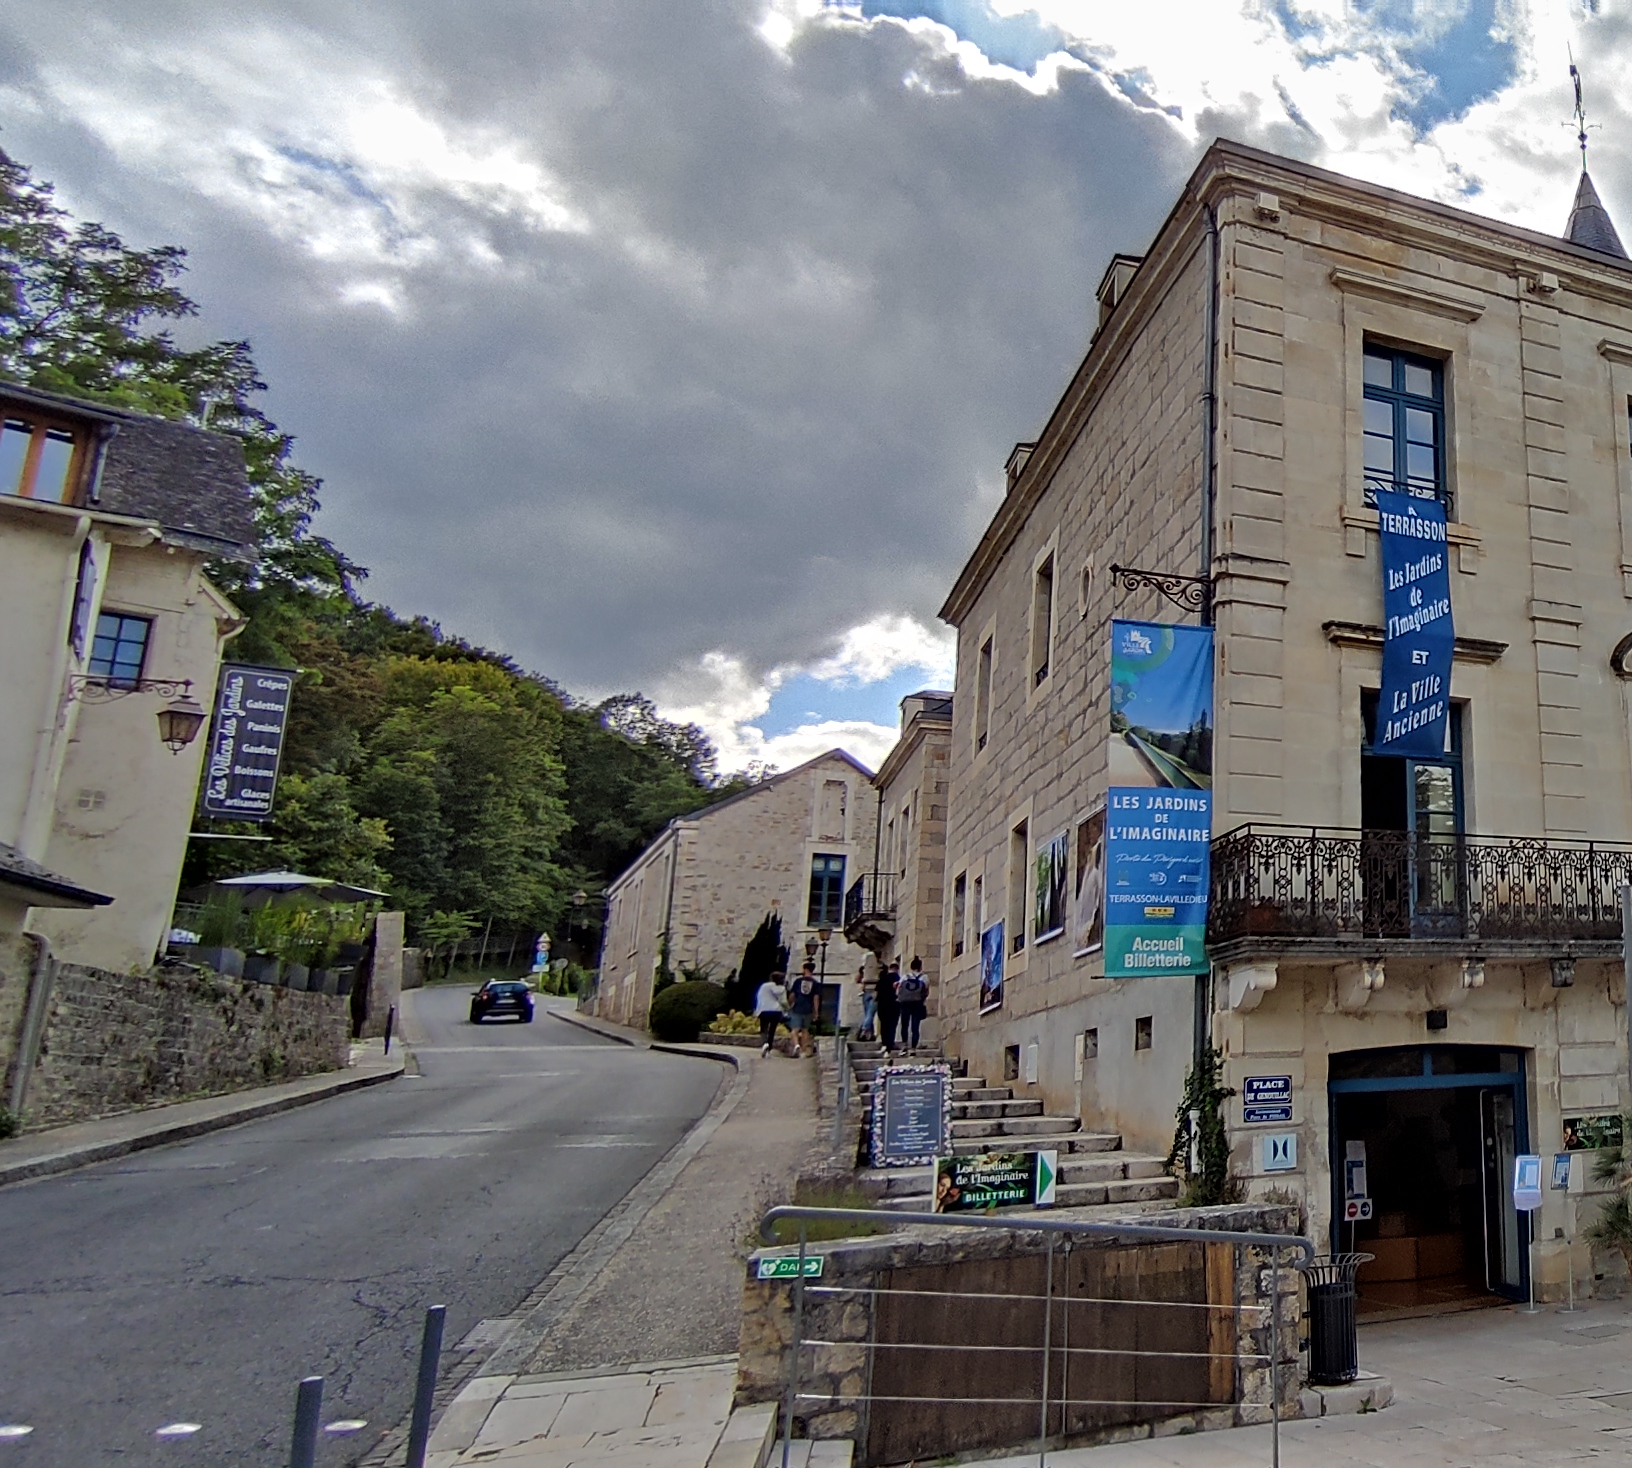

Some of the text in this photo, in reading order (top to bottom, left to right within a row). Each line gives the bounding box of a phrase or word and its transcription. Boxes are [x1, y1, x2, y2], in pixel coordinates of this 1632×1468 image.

[1381, 512, 1446, 541] TERRASSON
[1388, 553, 1442, 590] Les Jardins
[1410, 586, 1423, 607] de
[1412, 650, 1429, 665] ET
[221, 676, 246, 717] Jardins
[1393, 674, 1441, 714] La Ville
[246, 699, 285, 712] Galettes
[1382, 700, 1444, 744] Ancienne
[242, 743, 277, 756] Gaufres
[234, 765, 274, 777] Boissons
[241, 788, 270, 800] Glaces
[1113, 796, 1208, 812] LES JARDINS
[1154, 813, 1169, 824] DE
[1109, 826, 1210, 842] L'IMAGINAIRE
[1109, 894, 1208, 904] TERRASSON-LAVILLEDIEU
[1132, 936, 1184, 951] Accueil
[1124, 953, 1192, 968] Billetterie
[1252, 1081, 1285, 1090] PLACE
[956, 1161, 1013, 1174] Les Jardins
[956, 1176, 969, 1185] de
[965, 1189, 1025, 1202] BILLETTERIE
